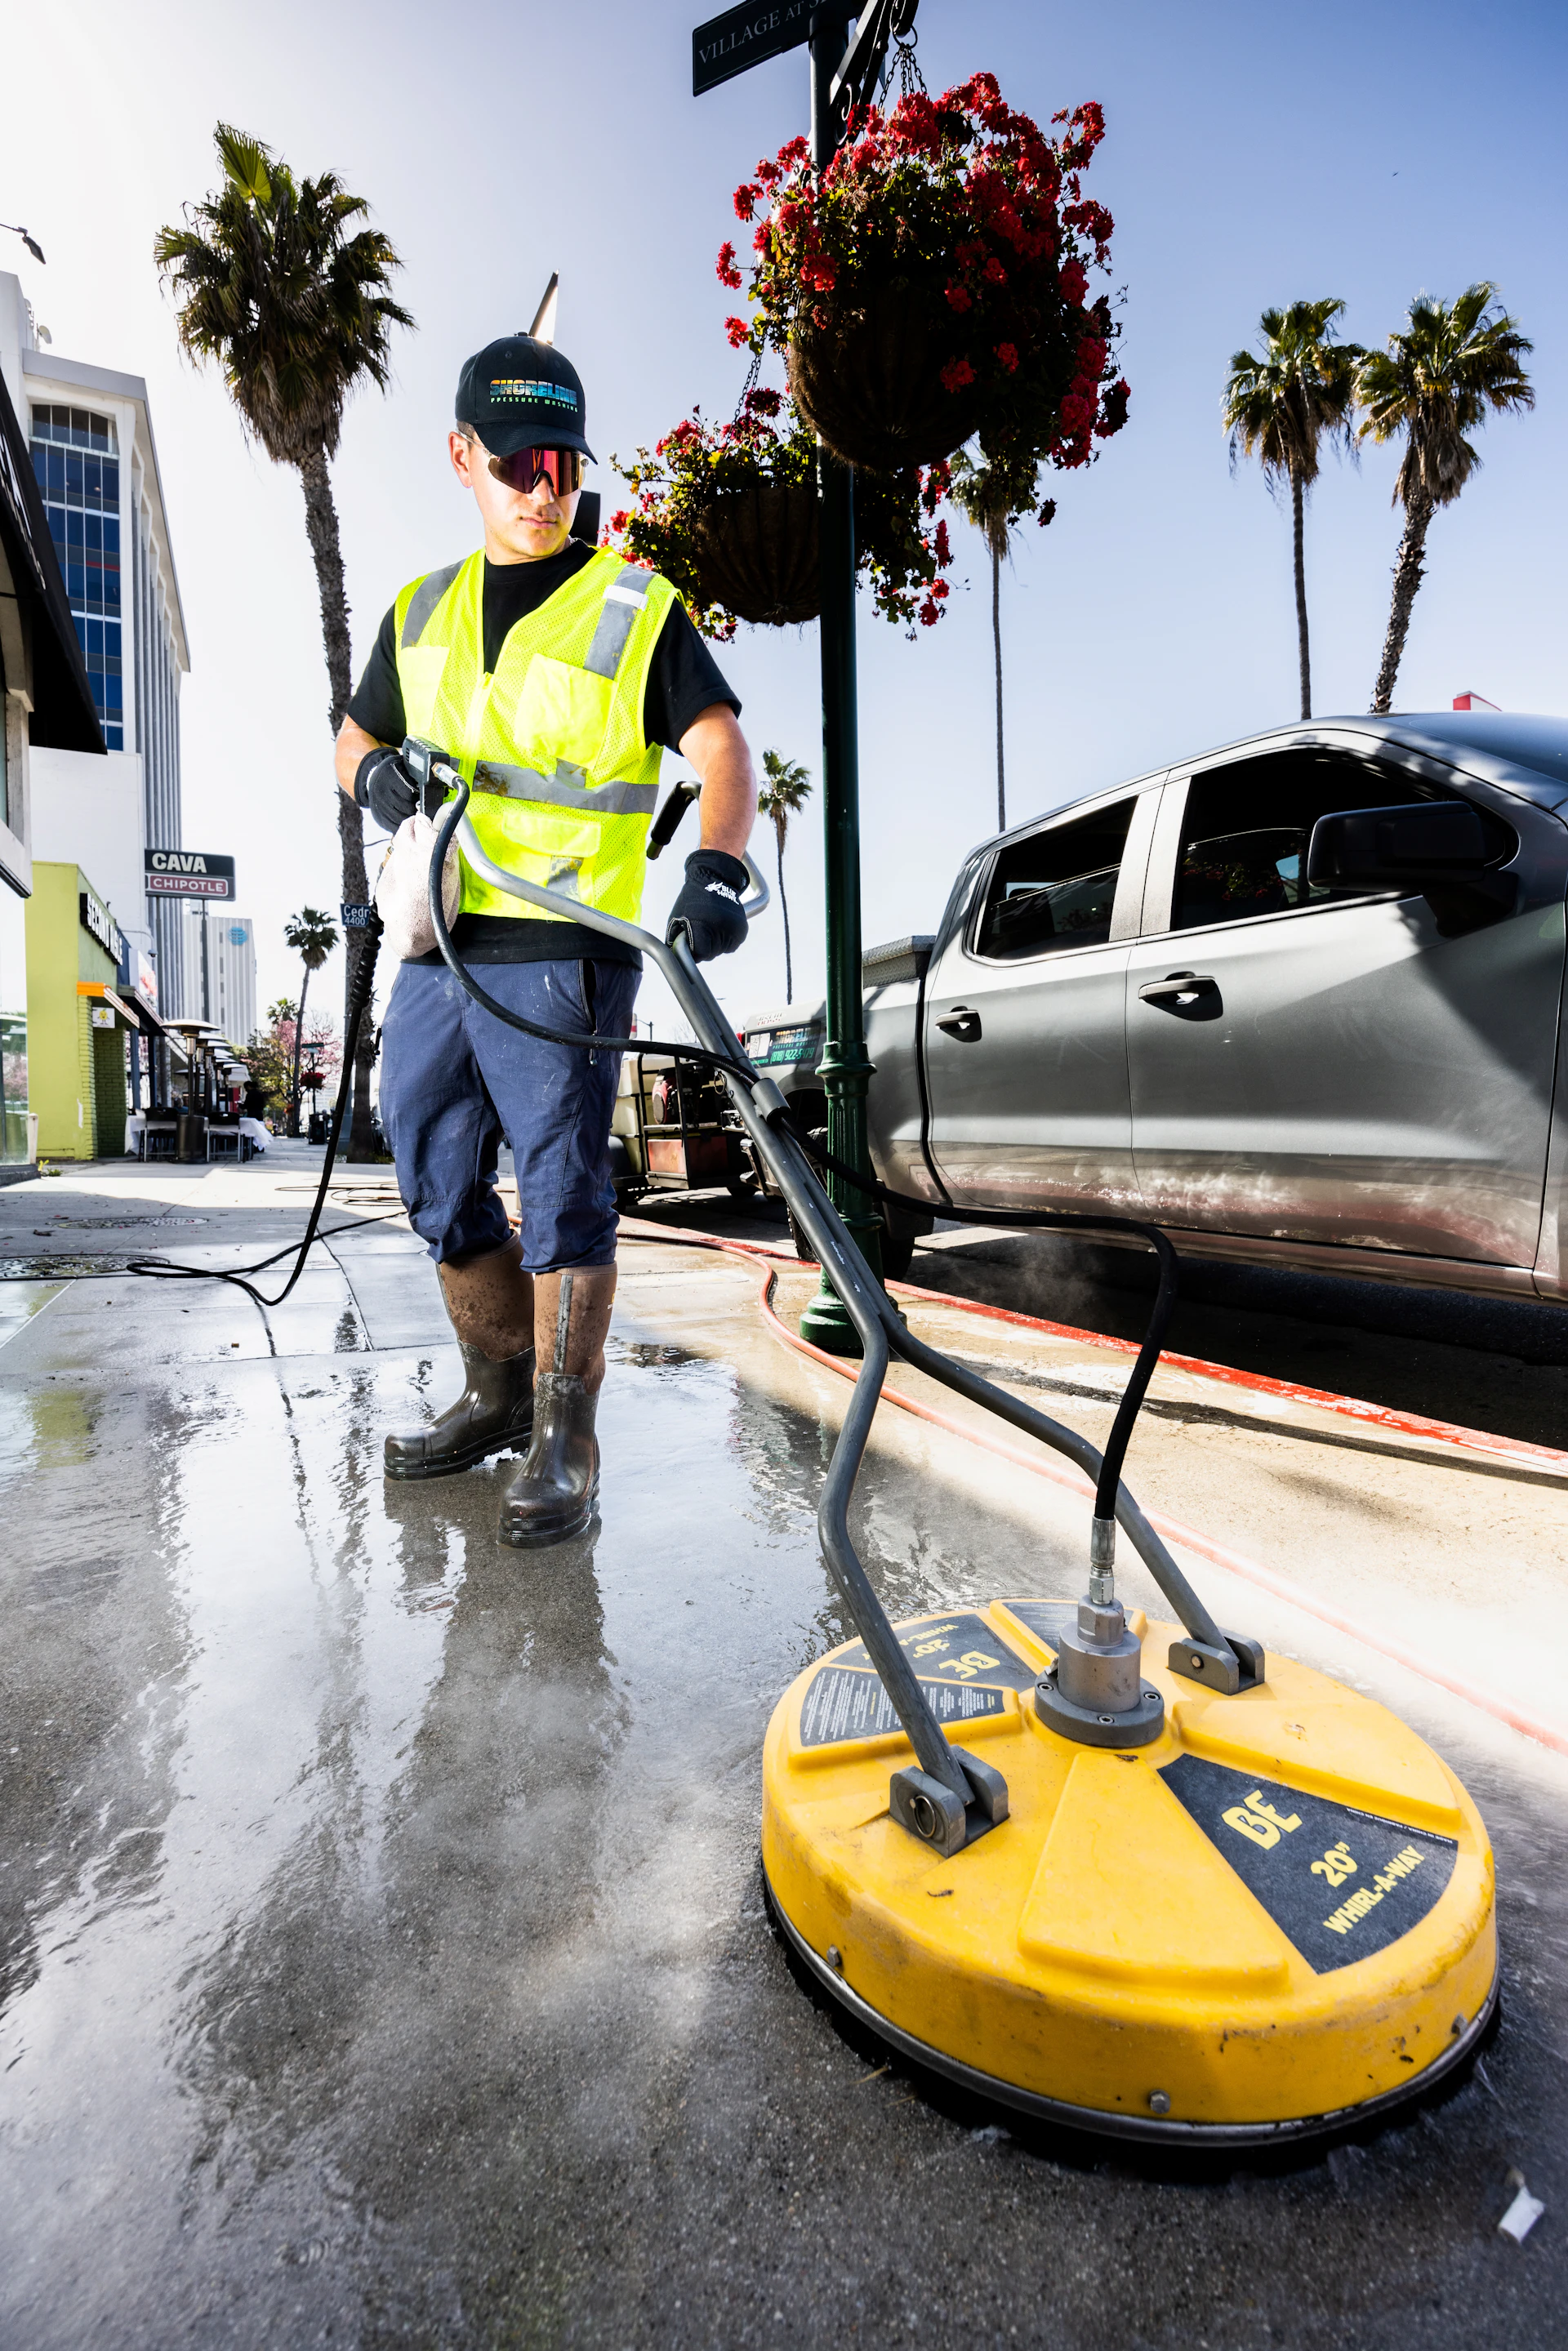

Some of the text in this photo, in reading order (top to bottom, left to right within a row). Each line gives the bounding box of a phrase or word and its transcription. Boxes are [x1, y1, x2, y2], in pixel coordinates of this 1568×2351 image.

[698, 2, 805, 64] VILLAGE AT
[152, 853, 207, 873] CAVA
[153, 878, 224, 893] CHIPOTLE
[343, 905, 370, 918] Cedr
[344, 916, 366, 925] 4400
[784, 1047, 815, 1061] 922-5479
[938, 1650, 1001, 1680] BE
[1221, 1789, 1303, 1850] BE
[1407, 1827, 1428, 1836] CHINA
[1322, 1845, 1426, 1935] WHIRL-A-WAY
